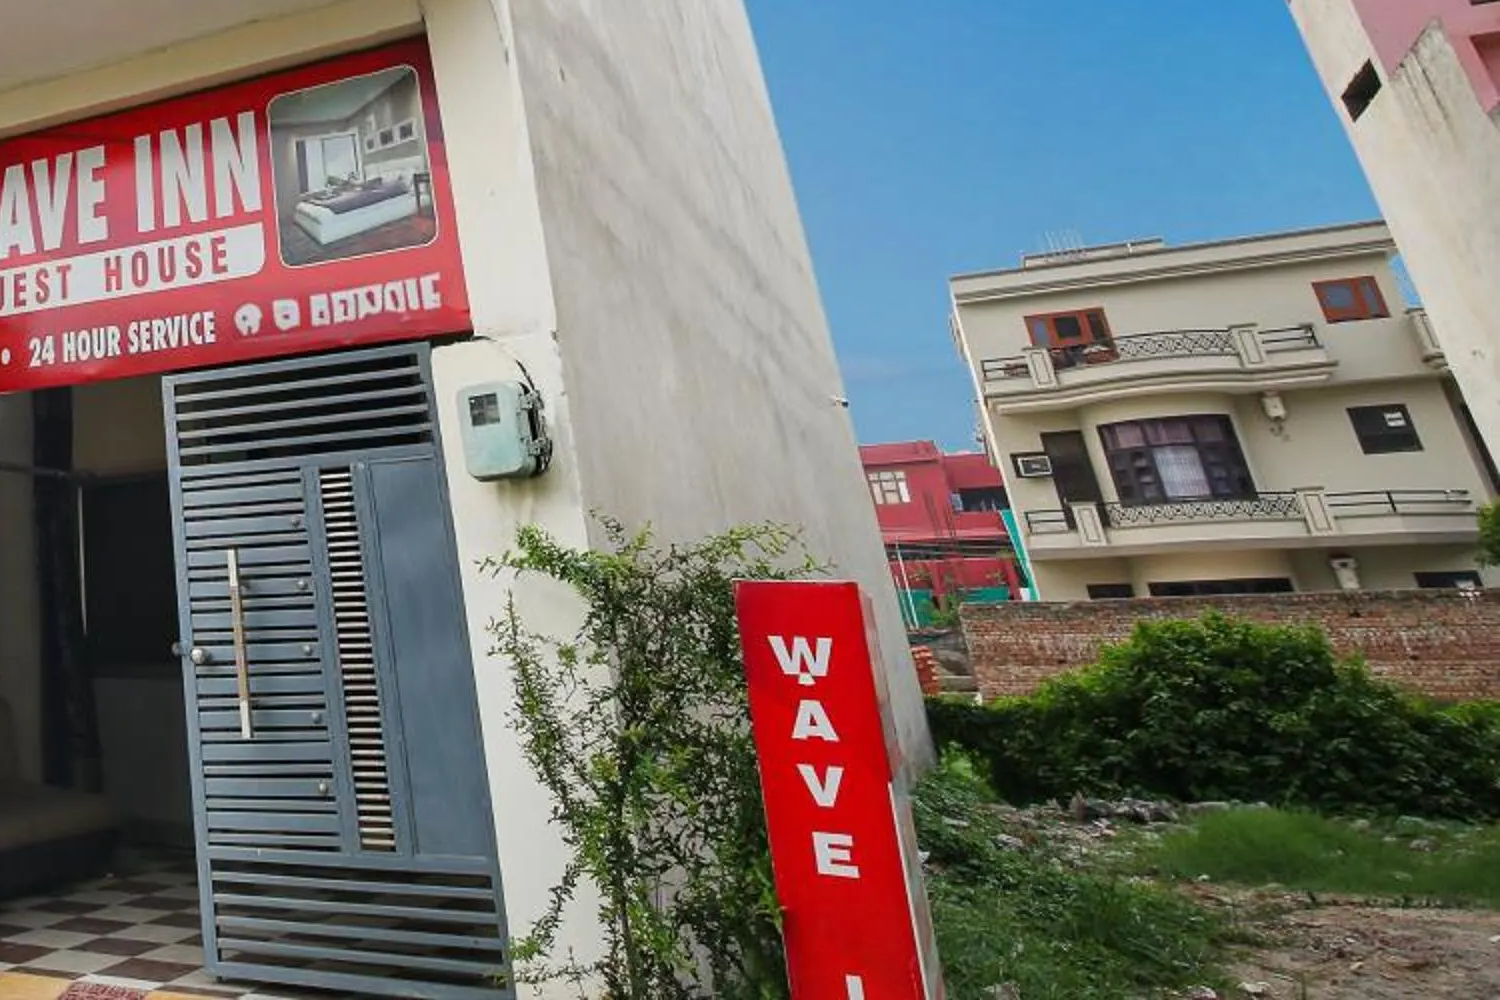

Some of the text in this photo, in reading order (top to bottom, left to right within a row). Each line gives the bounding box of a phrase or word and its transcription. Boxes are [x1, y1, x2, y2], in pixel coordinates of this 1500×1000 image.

[134, 111, 262, 232] INN
[104, 235, 229, 294] HOUSE
[29, 335, 55, 368] 24
[62, 323, 121, 363] HOUR
[127, 311, 216, 353] SERVICE
[767, 636, 860, 878] WAVE
